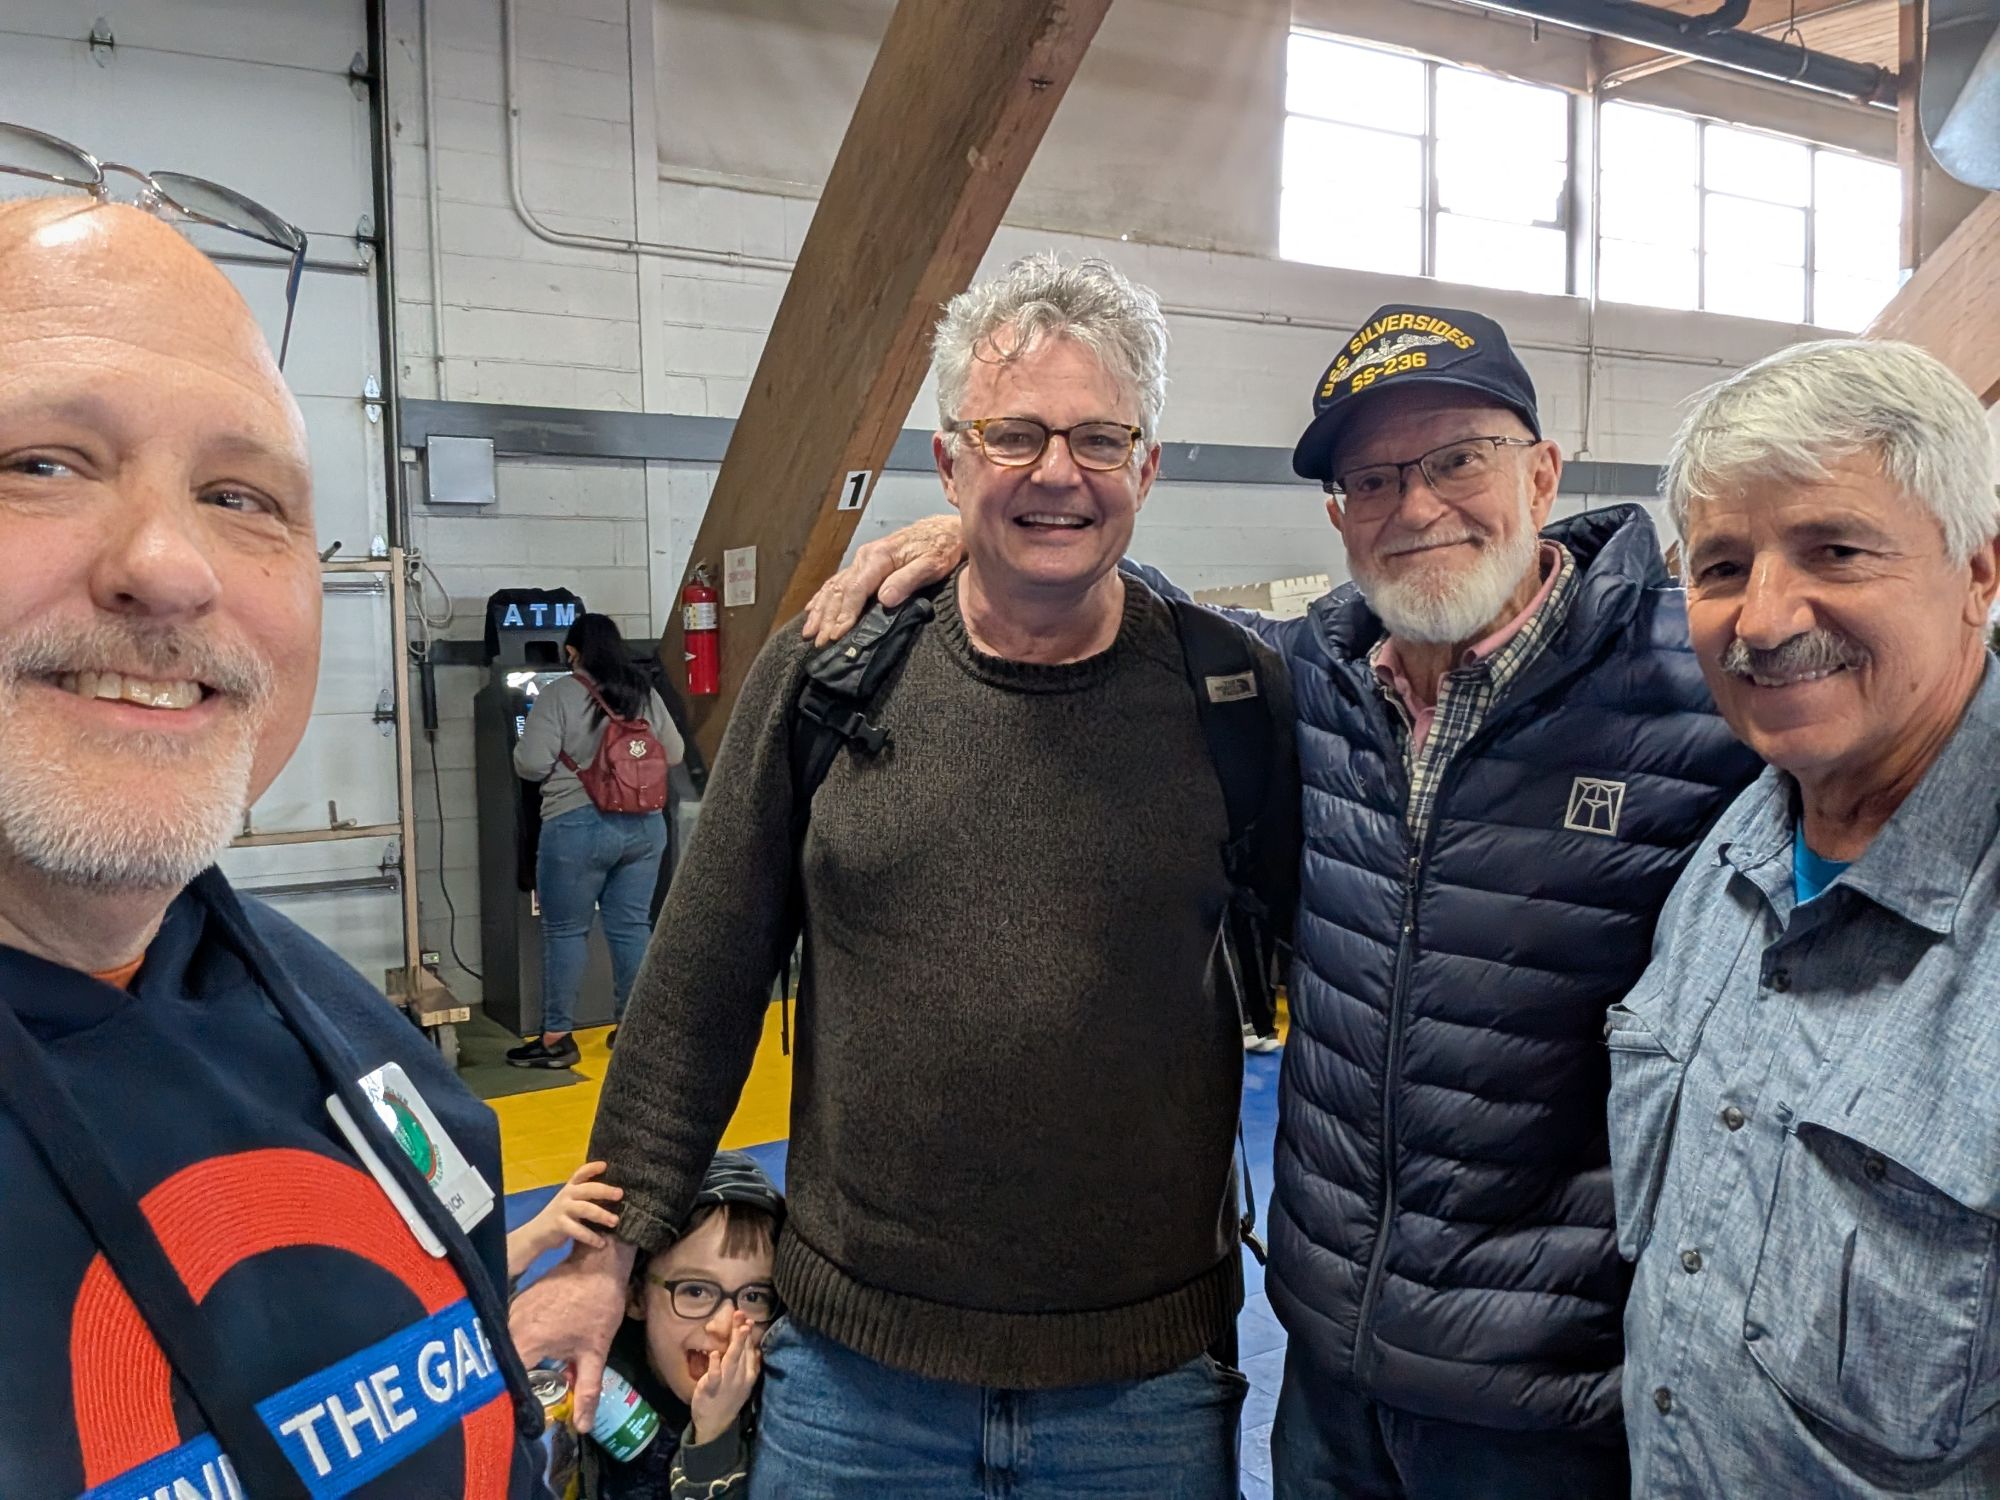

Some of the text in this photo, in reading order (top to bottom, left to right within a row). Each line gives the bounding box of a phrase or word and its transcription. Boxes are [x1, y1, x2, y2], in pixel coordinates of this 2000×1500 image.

[1322, 313, 1475, 397] USS SILVERSIDES
[1352, 352, 1427, 393] SS-236
[849, 473, 866, 507] 1
[503, 603, 576, 626] ATM
[280, 1364, 417, 1476] THE
